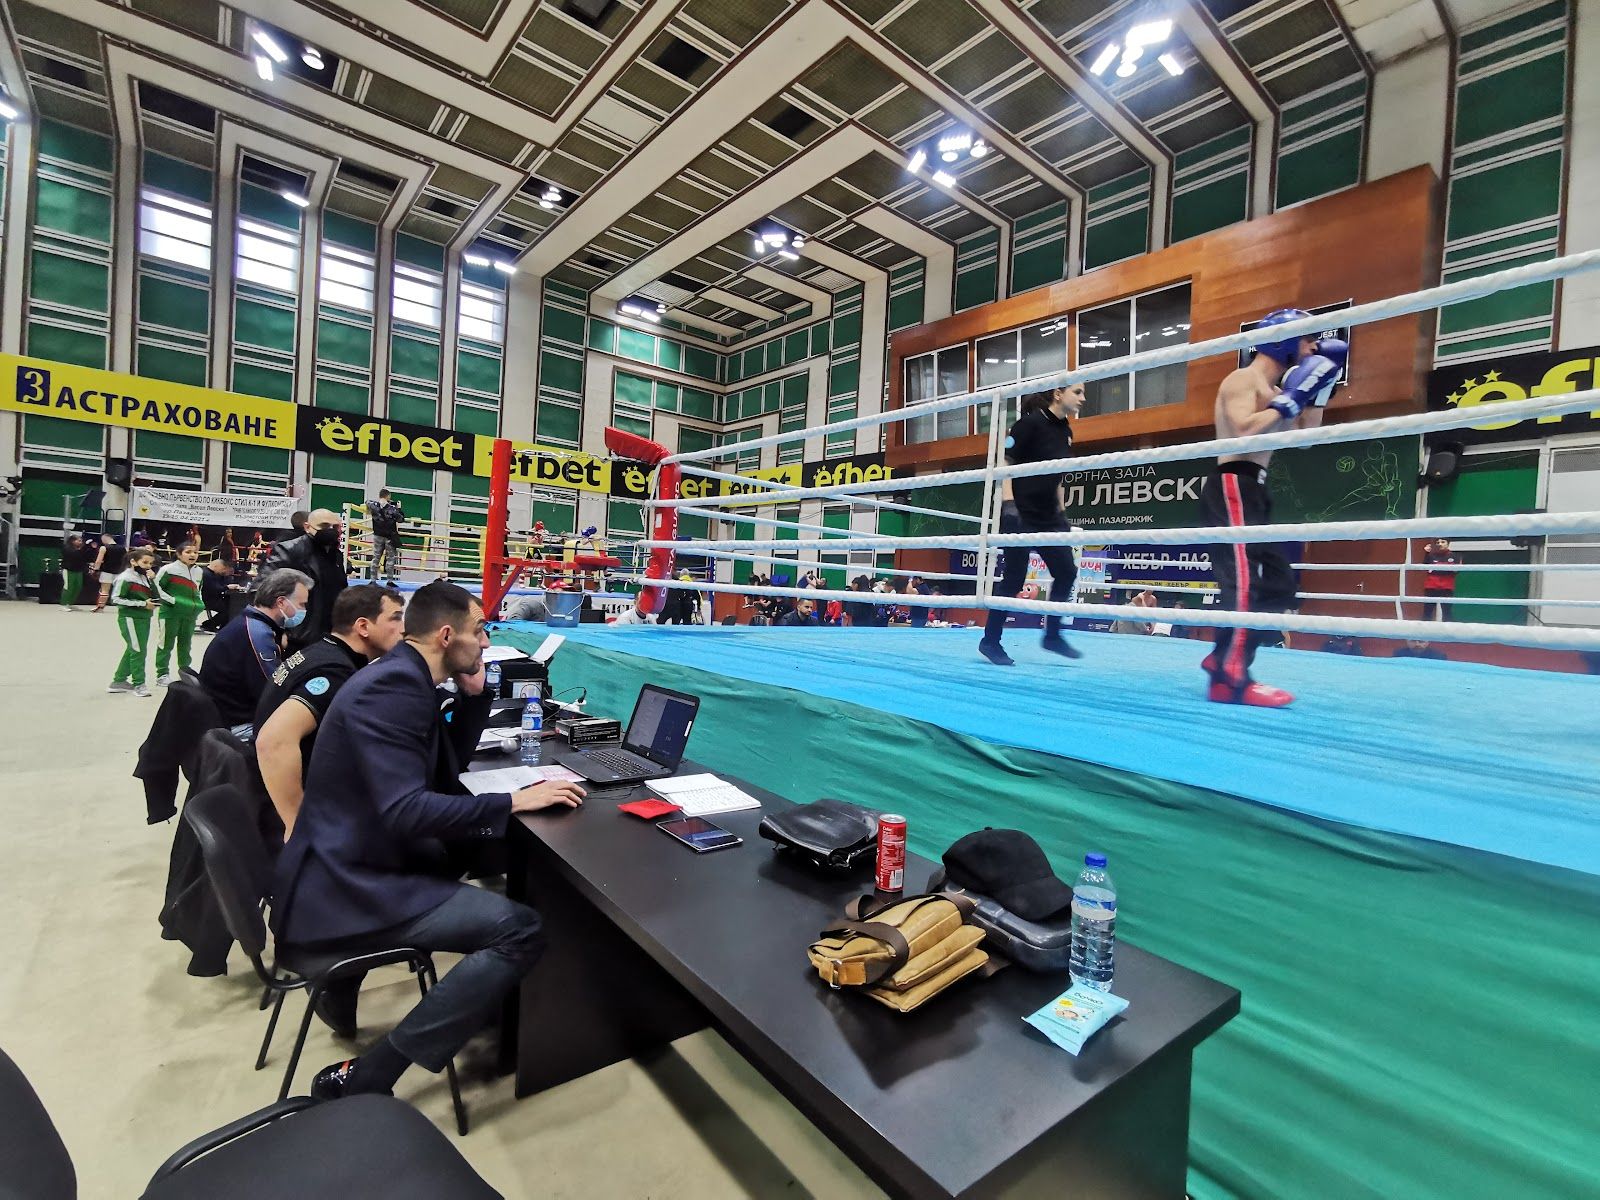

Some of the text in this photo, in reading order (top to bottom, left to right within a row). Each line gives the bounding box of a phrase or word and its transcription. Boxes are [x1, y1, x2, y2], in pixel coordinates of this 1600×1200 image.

[1457, 357, 1600, 430] ef
[320, 421, 463, 468] efbet
[624, 469, 713, 500] efet
[1114, 465, 1157, 480] ЗАЛА
[1099, 515, 1154, 525] ПАЗАРДЖИК
